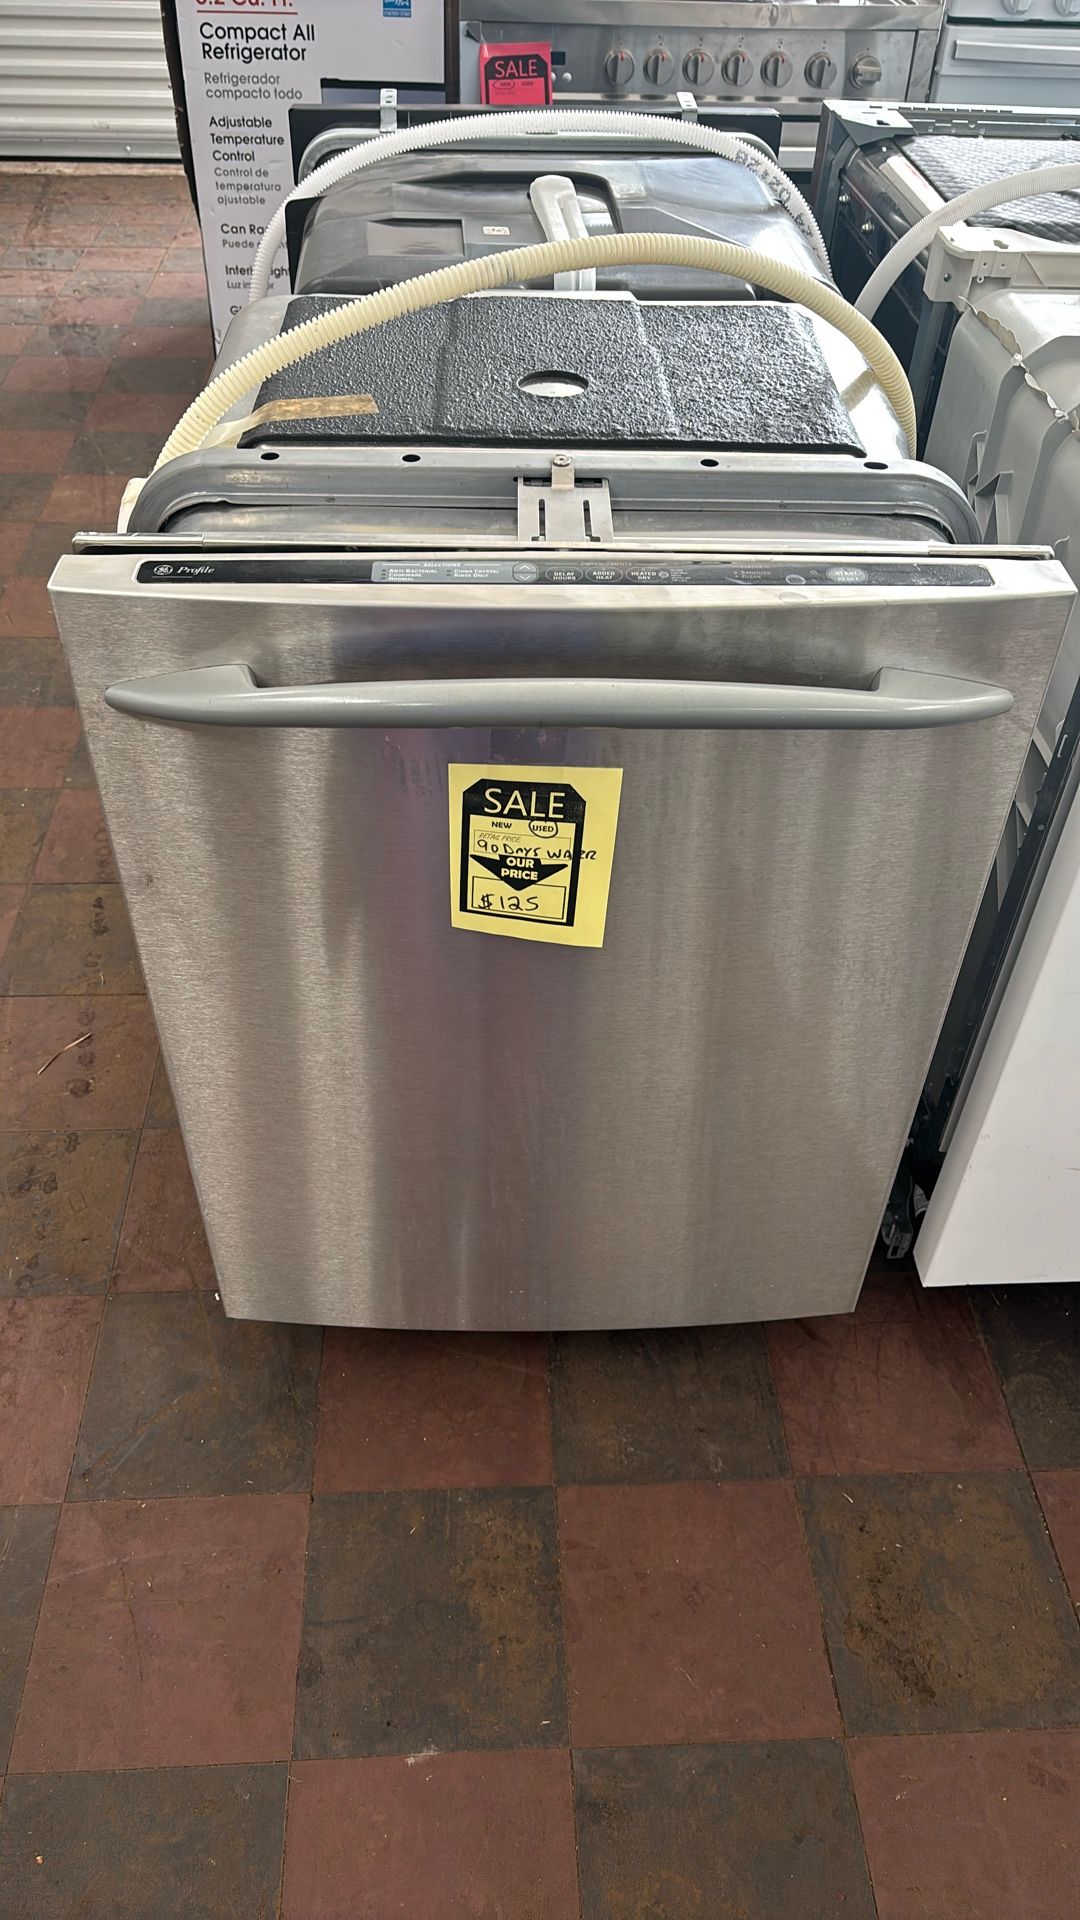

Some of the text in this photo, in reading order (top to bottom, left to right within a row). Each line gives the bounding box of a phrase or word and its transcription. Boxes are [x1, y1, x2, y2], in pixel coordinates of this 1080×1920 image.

[200, 22, 315, 43] Compact All
[202, 42, 306, 64] Refrigerator
[494, 59, 538, 78] SALE
[204, 72, 280, 87] Refrigerador
[206, 87, 302, 101] compacto todo
[209, 116, 272, 129] Adjustable
[210, 133, 284, 146] Temperature
[212, 150, 255, 161] Control
[214, 167, 268, 177] Control de
[216, 181, 281, 192] temperatura
[217, 196, 265, 206] ajustable
[221, 223, 246, 234] Can
[222, 240, 254, 248] Puede
[177, 566, 215, 575] Profile
[484, 788, 565, 819] SALE
[491, 821, 554, 833] NEW USED
[477, 839, 499, 853] 90
[506, 857, 535, 869] OUR
[501, 868, 538, 881] PRICE
[478, 893, 539, 911] $125
